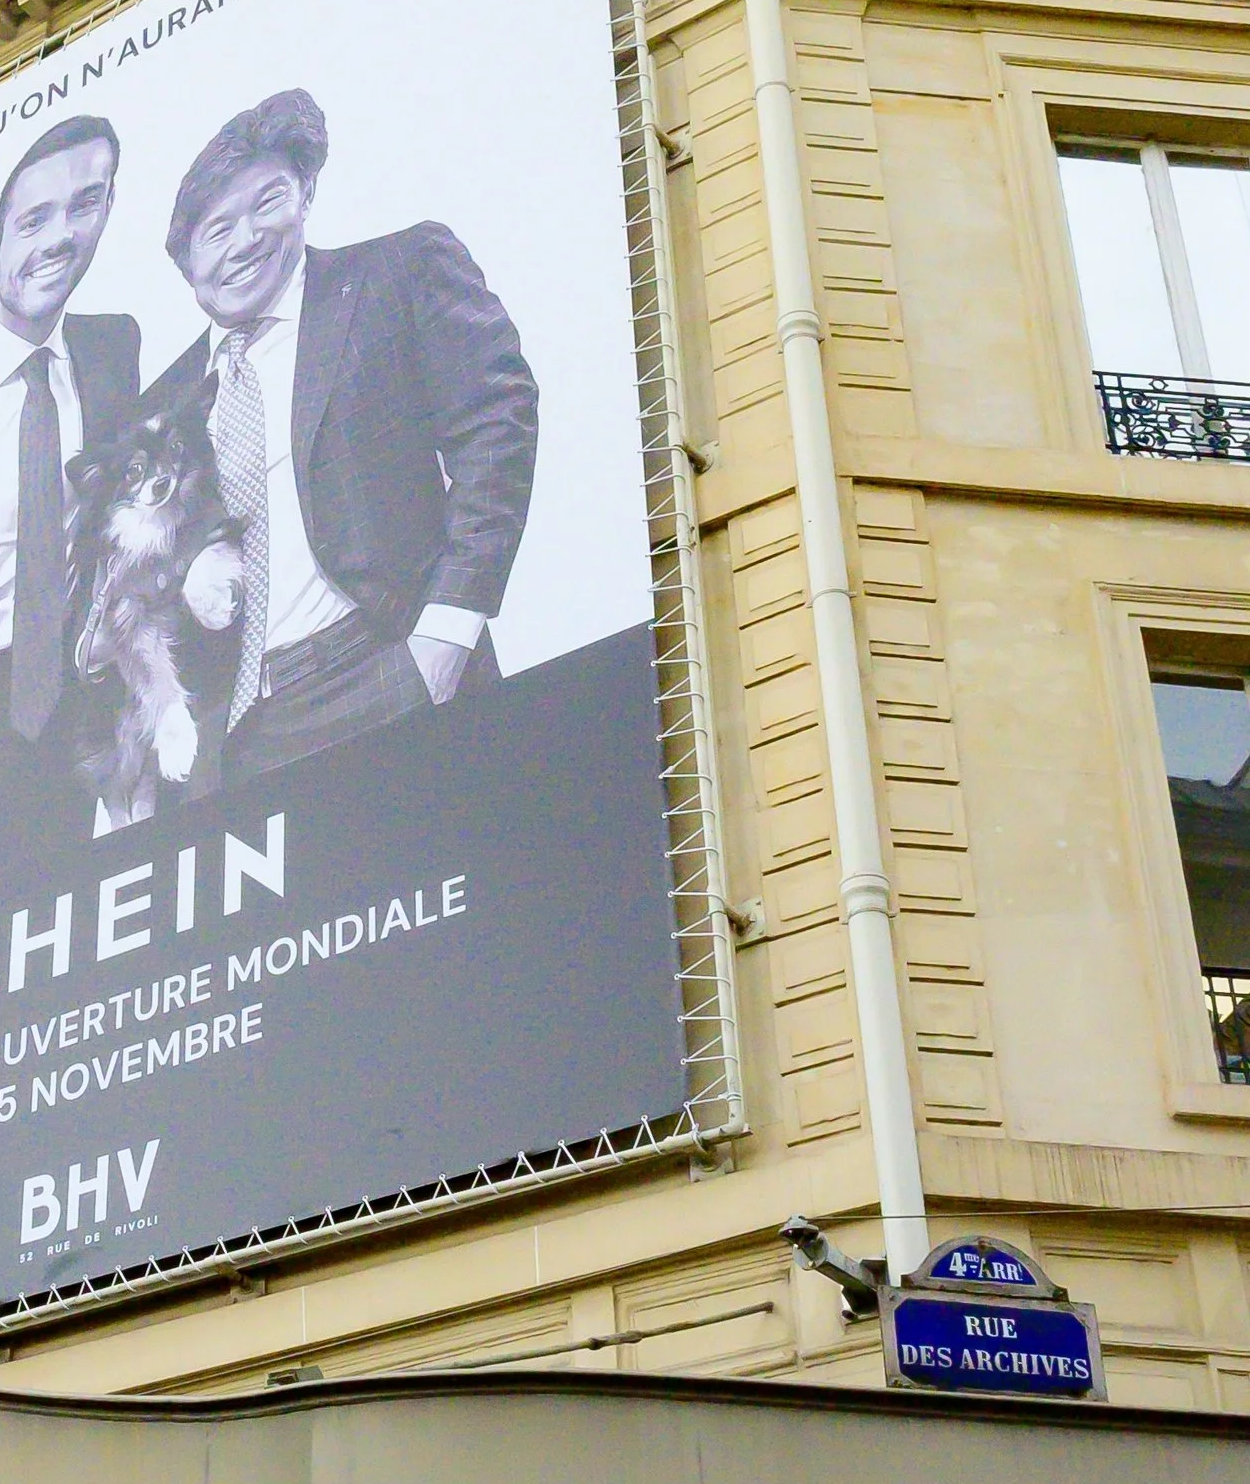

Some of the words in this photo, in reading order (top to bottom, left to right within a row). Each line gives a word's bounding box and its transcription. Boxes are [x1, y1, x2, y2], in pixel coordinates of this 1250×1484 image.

[227, 873, 467, 992] MONDIALE
[30, 1003, 265, 1112] NOVEMBRE
[20, 1138, 161, 1245] BHV
[19, 1251, 34, 1264] 52
[47, 1240, 71, 1256] RUE
[84, 1232, 100, 1245] DE
[114, 1215, 158, 1236] RIVOLI
[901, 1344, 953, 1368] DES
[959, 1348, 1091, 1379] ARCHIVES
[964, 1315, 1018, 1339] RUE
